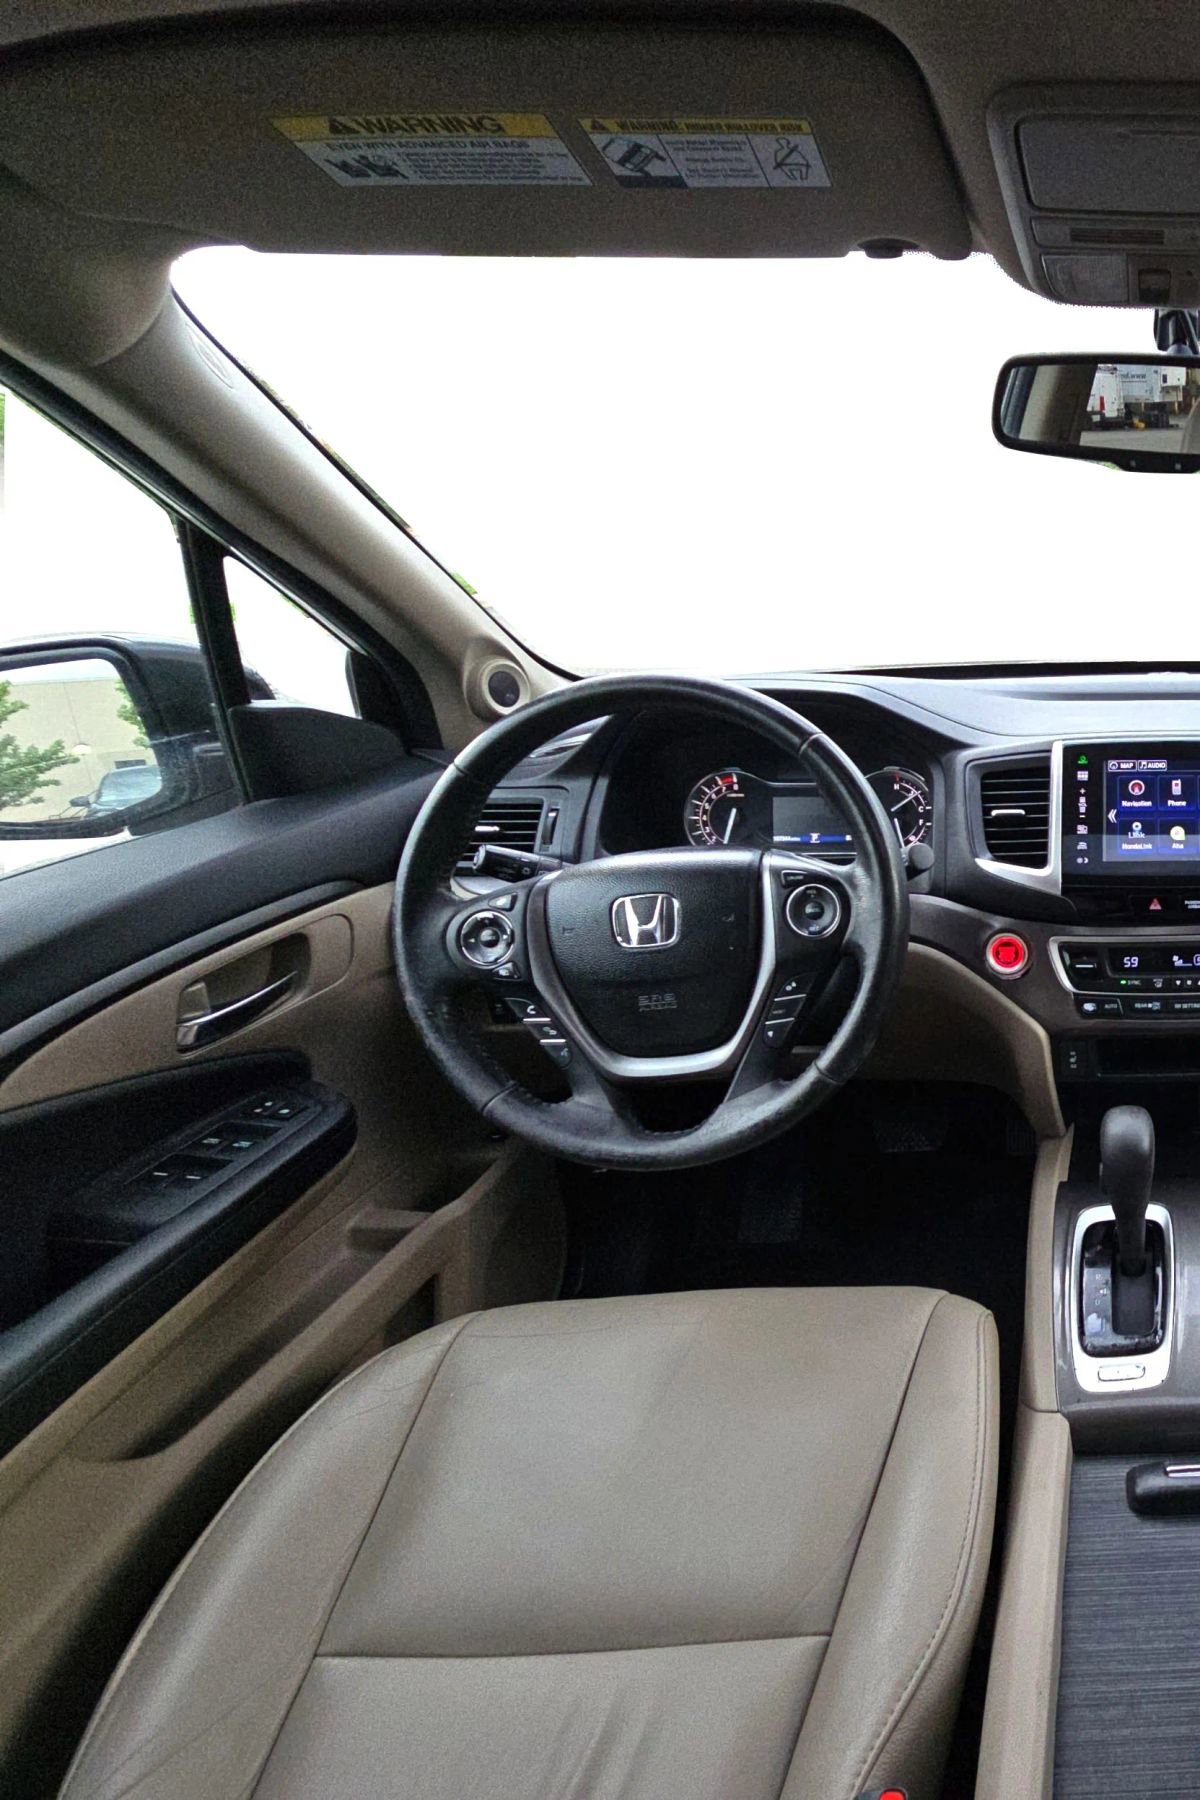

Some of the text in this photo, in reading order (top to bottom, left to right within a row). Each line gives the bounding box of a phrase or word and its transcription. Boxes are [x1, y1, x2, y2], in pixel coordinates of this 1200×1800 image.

[350, 115, 505, 134] WARNING
[364, 141, 397, 150] WITH
[1121, 800, 1153, 808] Navigation
[1167, 799, 1187, 807] Phone
